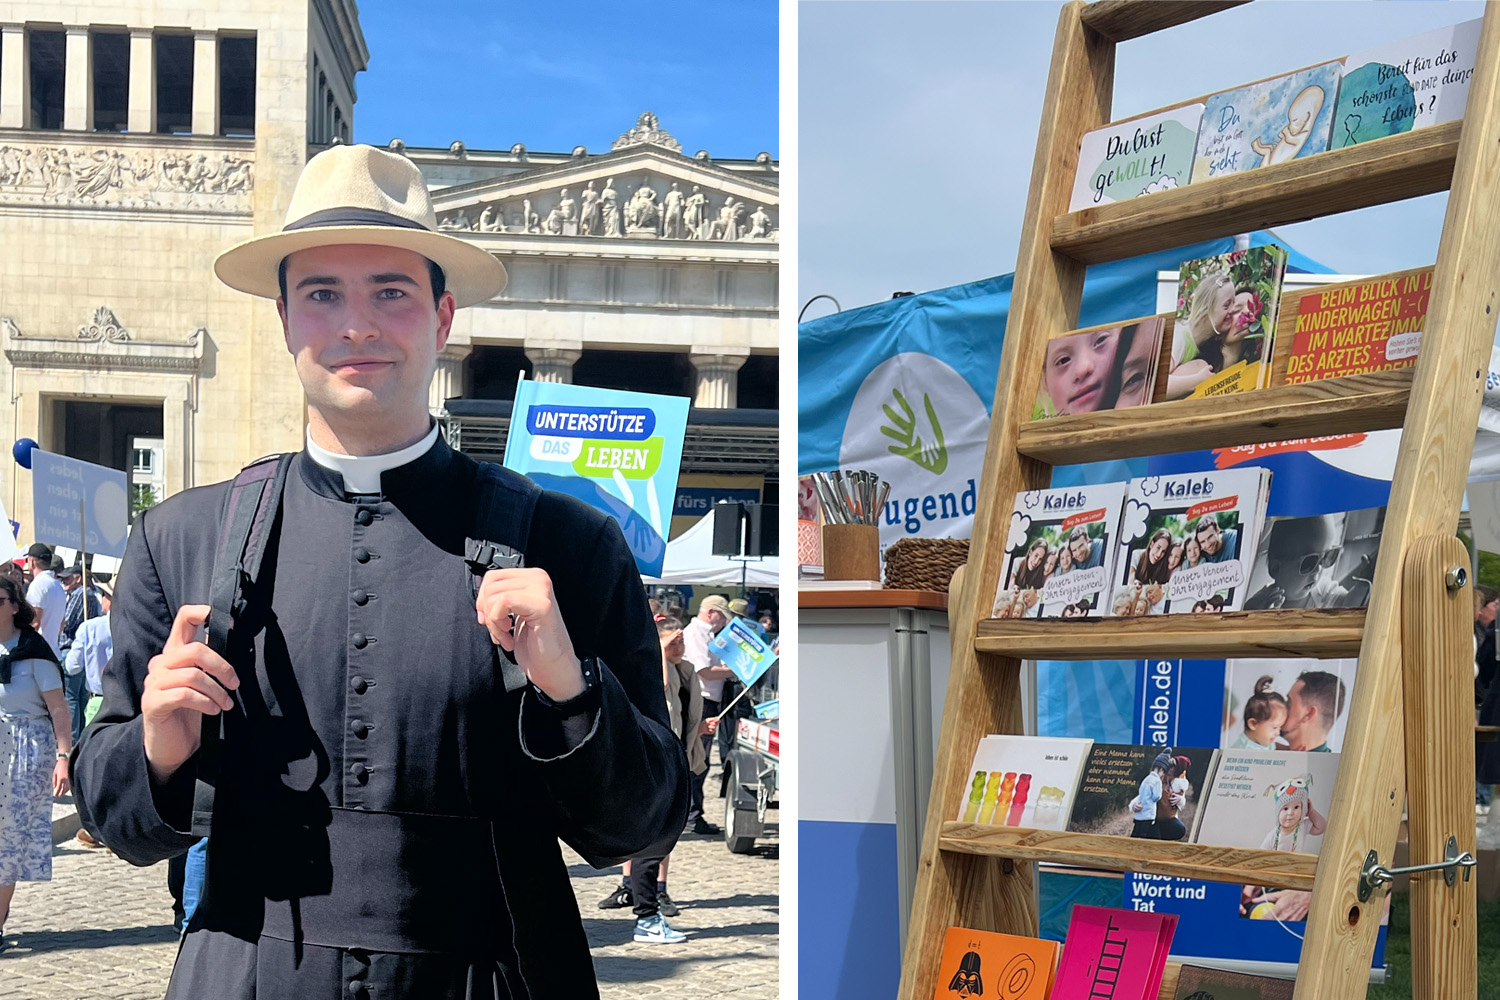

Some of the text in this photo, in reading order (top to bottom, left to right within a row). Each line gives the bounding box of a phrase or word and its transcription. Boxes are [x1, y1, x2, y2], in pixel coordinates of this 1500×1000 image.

[1378, 49, 1458, 85] Bereit für das
[1352, 84, 1397, 107] schönste
[1218, 105, 1240, 133] Du
[1320, 287, 1357, 309] BEIM
[1360, 279, 1400, 303] BLICK
[1403, 272, 1420, 294] IN
[1295, 297, 1402, 333] KINDERWAGEN
[1308, 314, 1427, 351] IM WARTEZIMM
[1286, 353, 1315, 375] DES
[1316, 345, 1372, 371] ARZTES
[1204, 370, 1242, 397] LEBENSFREUDE
[535, 409, 646, 434] UNTERSTÜTZE
[542, 440, 649, 471] DAS LEBEN
[1163, 477, 1214, 498] Kaleb
[677, 495, 707, 509] fürs
[885, 478, 977, 534] ugend
[1043, 491, 1087, 511] Kaleb
[1060, 579, 1104, 602] Engagement
[1188, 573, 1240, 598] Engagement
[1094, 749, 1145, 758] Eine Mama kann
[1102, 776, 1114, 785] eine
[1116, 778, 1137, 786] Mama
[1103, 767, 1131, 776] niemand
[1132, 881, 1206, 900] Wort und
[1131, 898, 1155, 913] Tat
